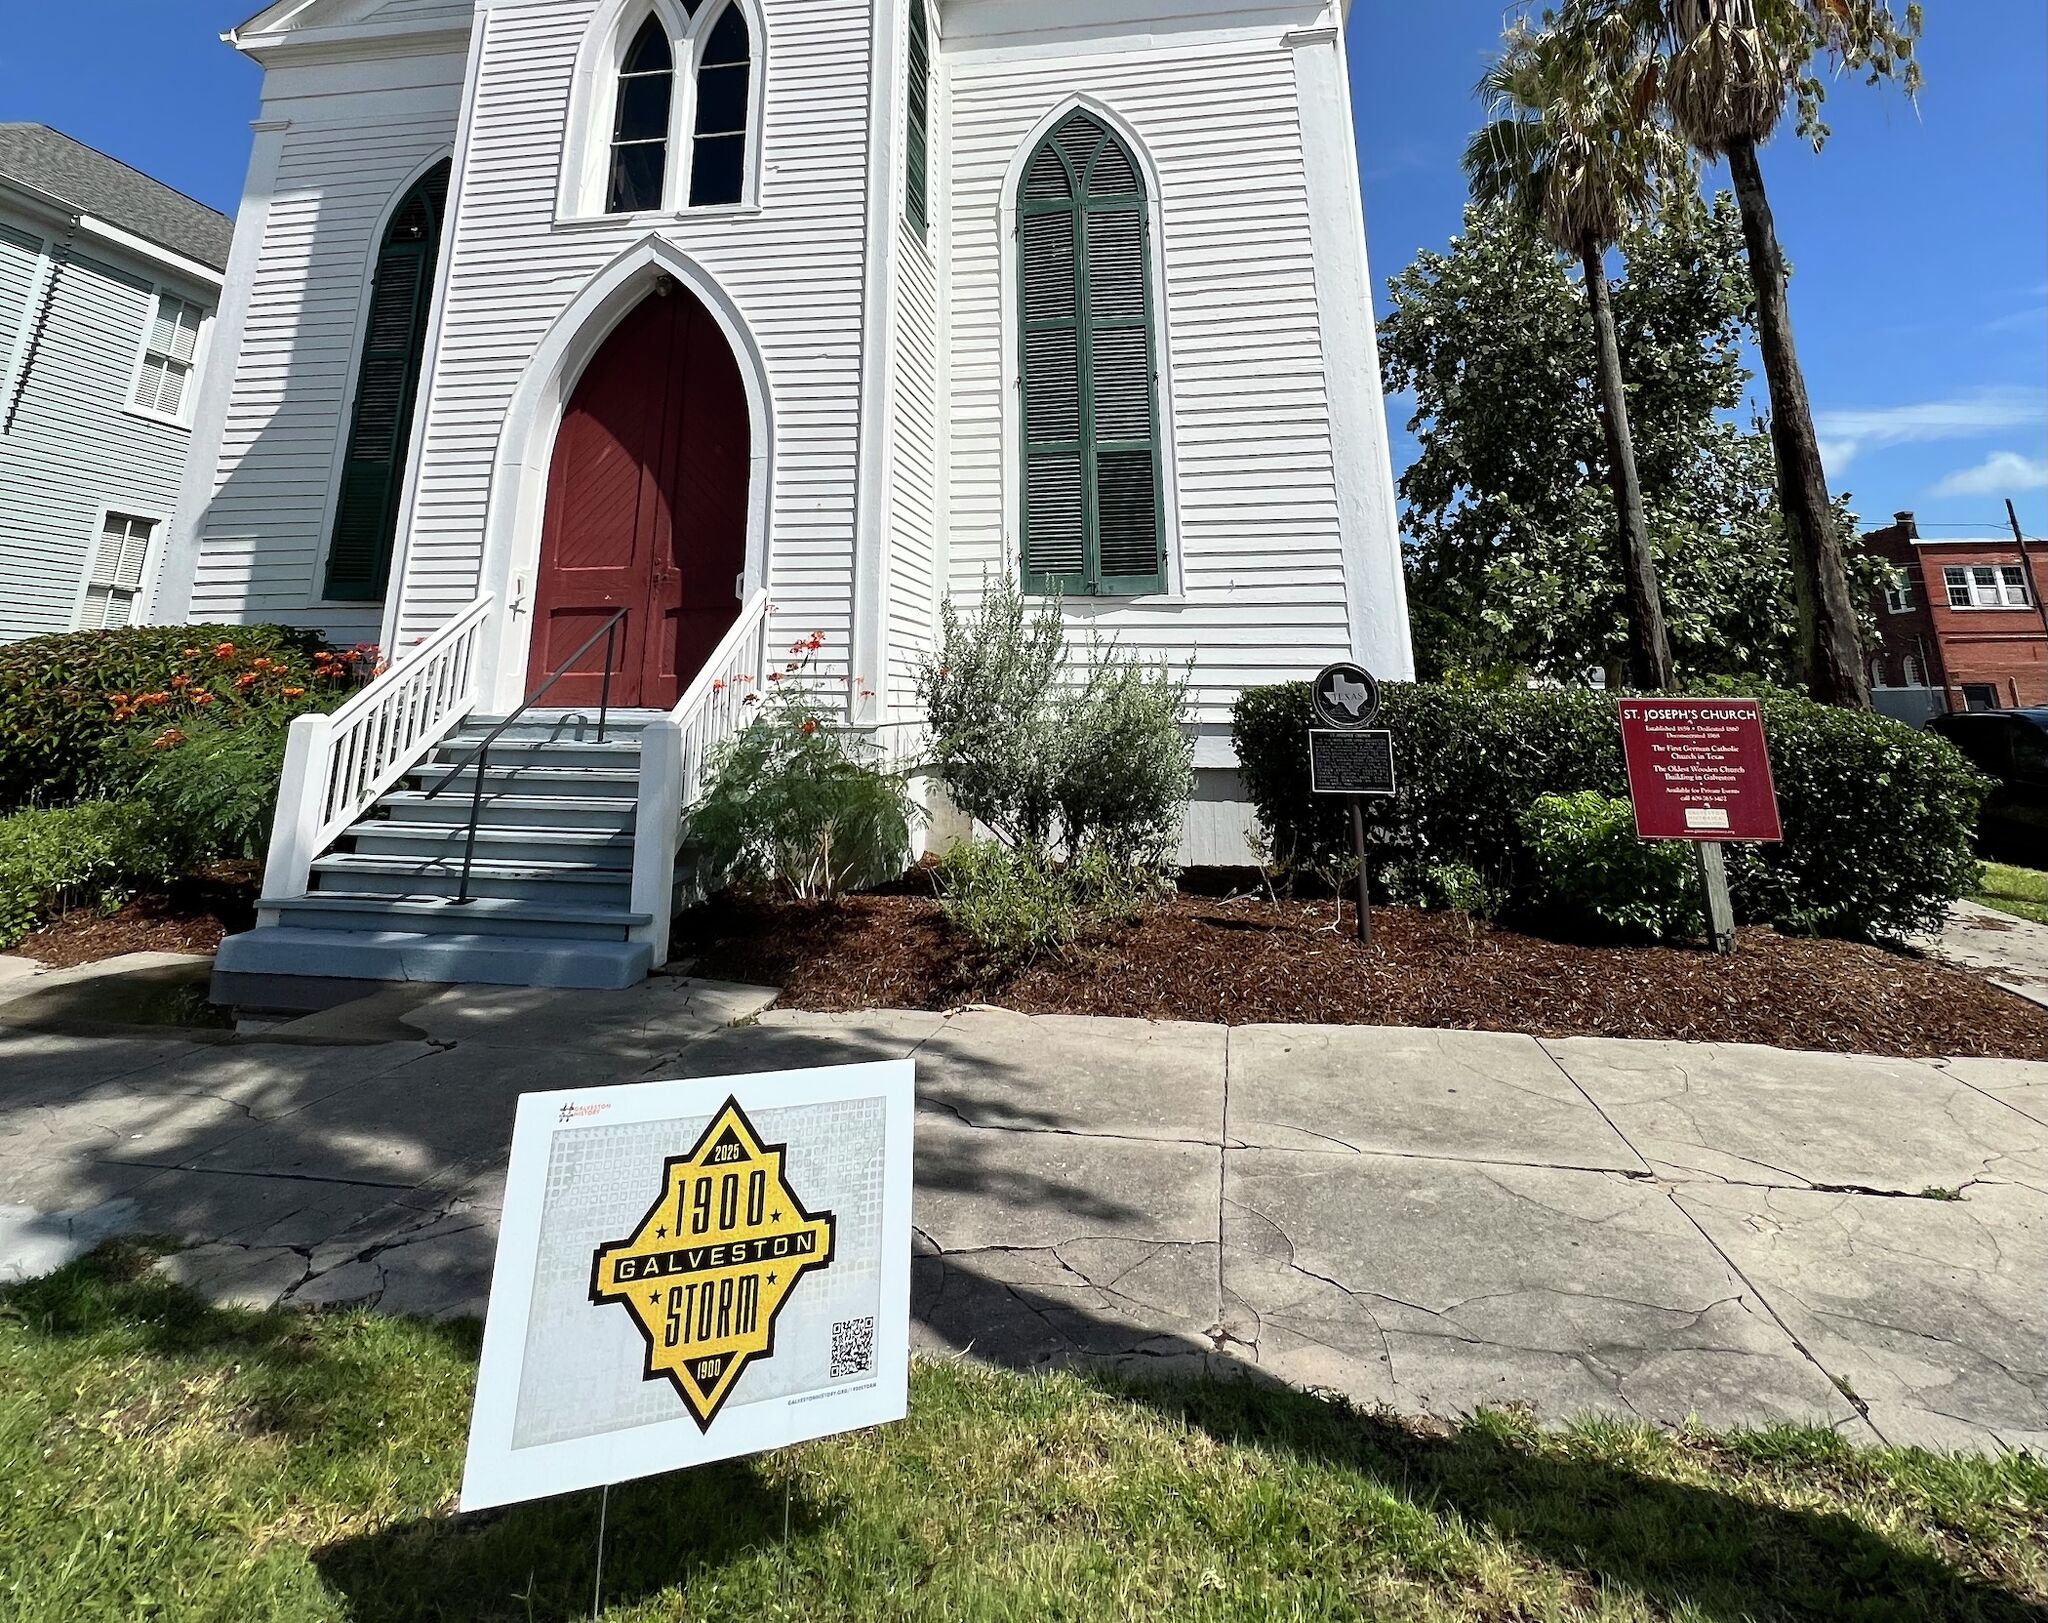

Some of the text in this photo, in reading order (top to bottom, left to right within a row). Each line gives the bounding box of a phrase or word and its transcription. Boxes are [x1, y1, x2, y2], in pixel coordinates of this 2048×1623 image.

[1331, 693, 1363, 701] TEXAS
[1623, 709, 1757, 722] ST. JOSEPH'S CHURCH
[1651, 744, 1739, 752] The First German Catholic
[1671, 752, 1697, 760] Church
[1653, 764, 1667, 772] The
[1667, 764, 1690, 772] Oldest
[1690, 765, 1719, 773] Wooden
[1665, 773, 1695, 781] Building
[1703, 774, 1737, 782] Galveston
[714, 1143, 740, 1162] 2025
[675, 1169, 766, 1238] 1900
[619, 1233, 813, 1280] GALVESTON
[664, 1273, 759, 1348] STORM
[697, 1358, 721, 1381] 1900
